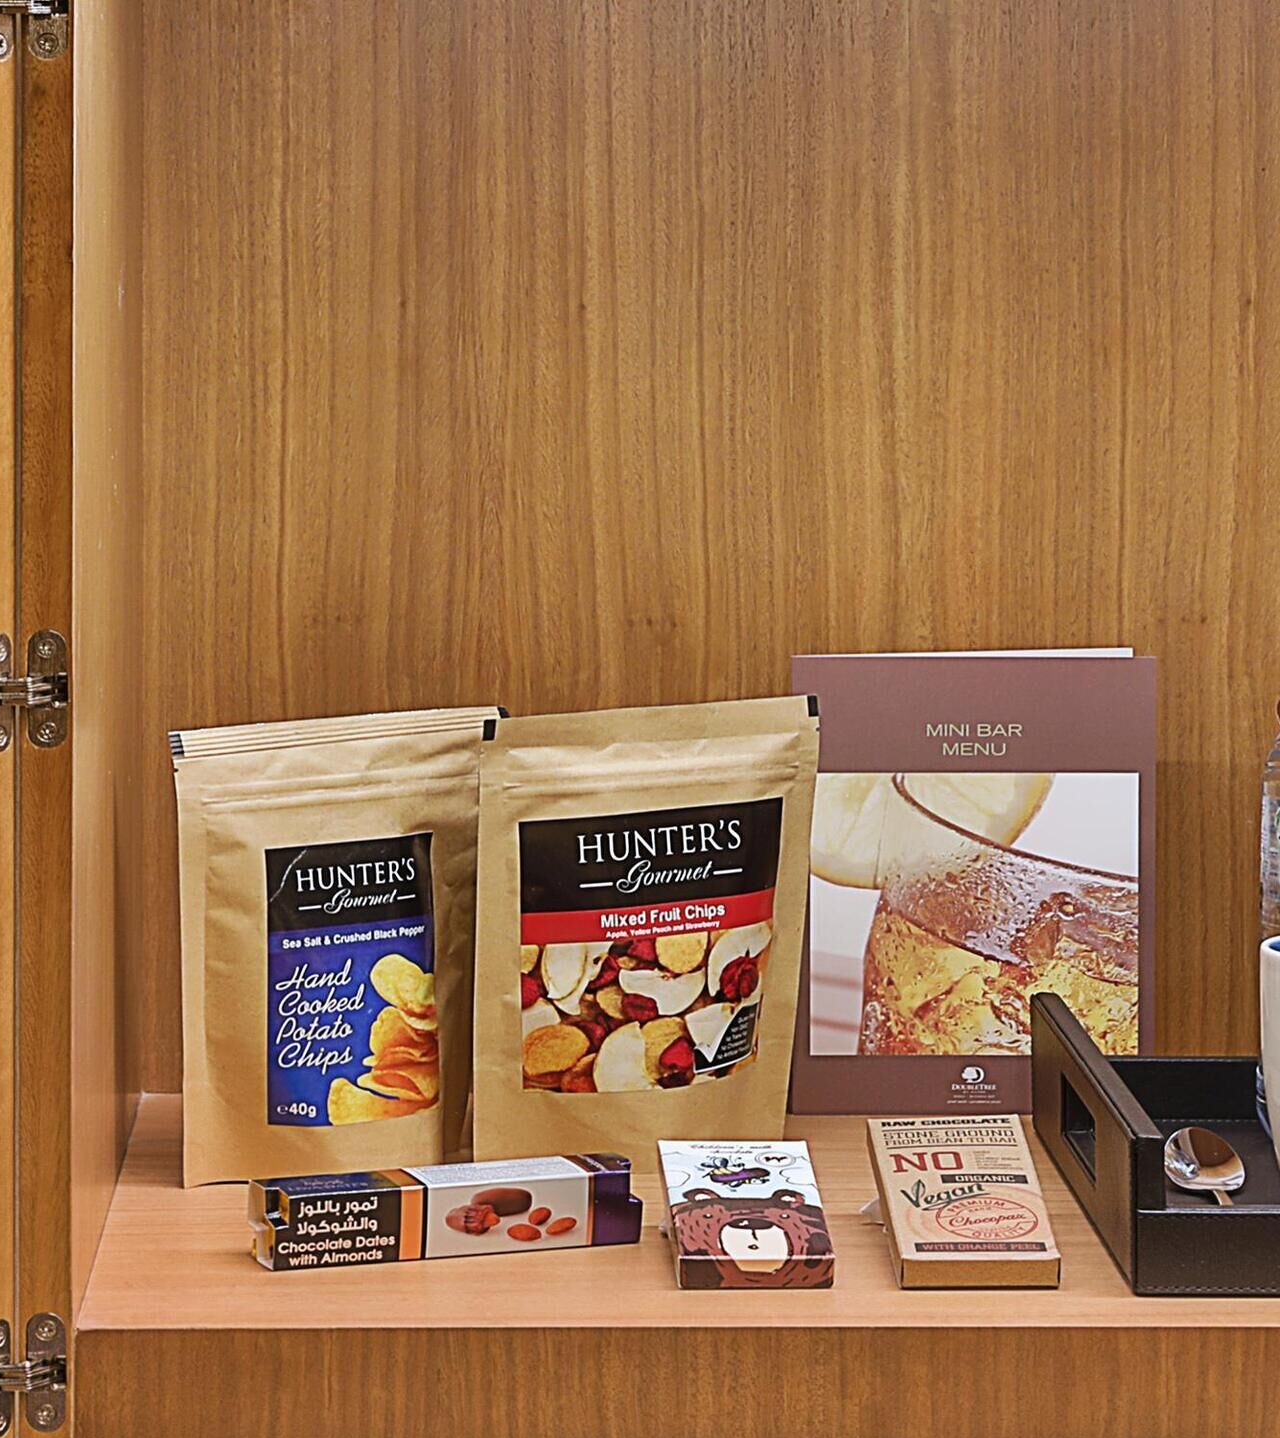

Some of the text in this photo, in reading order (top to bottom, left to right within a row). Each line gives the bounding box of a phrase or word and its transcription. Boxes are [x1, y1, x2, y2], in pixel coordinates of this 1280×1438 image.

[925, 722, 1023, 737] MINI BAR
[942, 742, 1007, 756] MENU
[615, 859, 713, 893] Gourmet
[323, 888, 398, 915] Gourmet
[600, 904, 725, 928] Mixed Fruit Chips
[282, 924, 425, 950] Sea Salt & Crushed Black Pepper
[630, 928, 651, 936] Yellow
[652, 926, 672, 934] Peach
[685, 920, 720, 930] Strawberry
[275, 958, 353, 991] Hand
[277, 984, 365, 1018] Cooked
[275, 1014, 353, 1045] Potato
[277, 1040, 354, 1076] Chips
[921, 1118, 1010, 1126] CHOCOLATE
[883, 1131, 939, 1139] STONE
[889, 1151, 964, 1173] NO
[900, 1178, 985, 1208] Vegan
[298, 1196, 378, 1218] تمور باللوز
[296, 1216, 378, 1236] والشوكولا
[278, 1235, 396, 1254] Chocolate Dates
[289, 1249, 383, 1266] with Almonds
